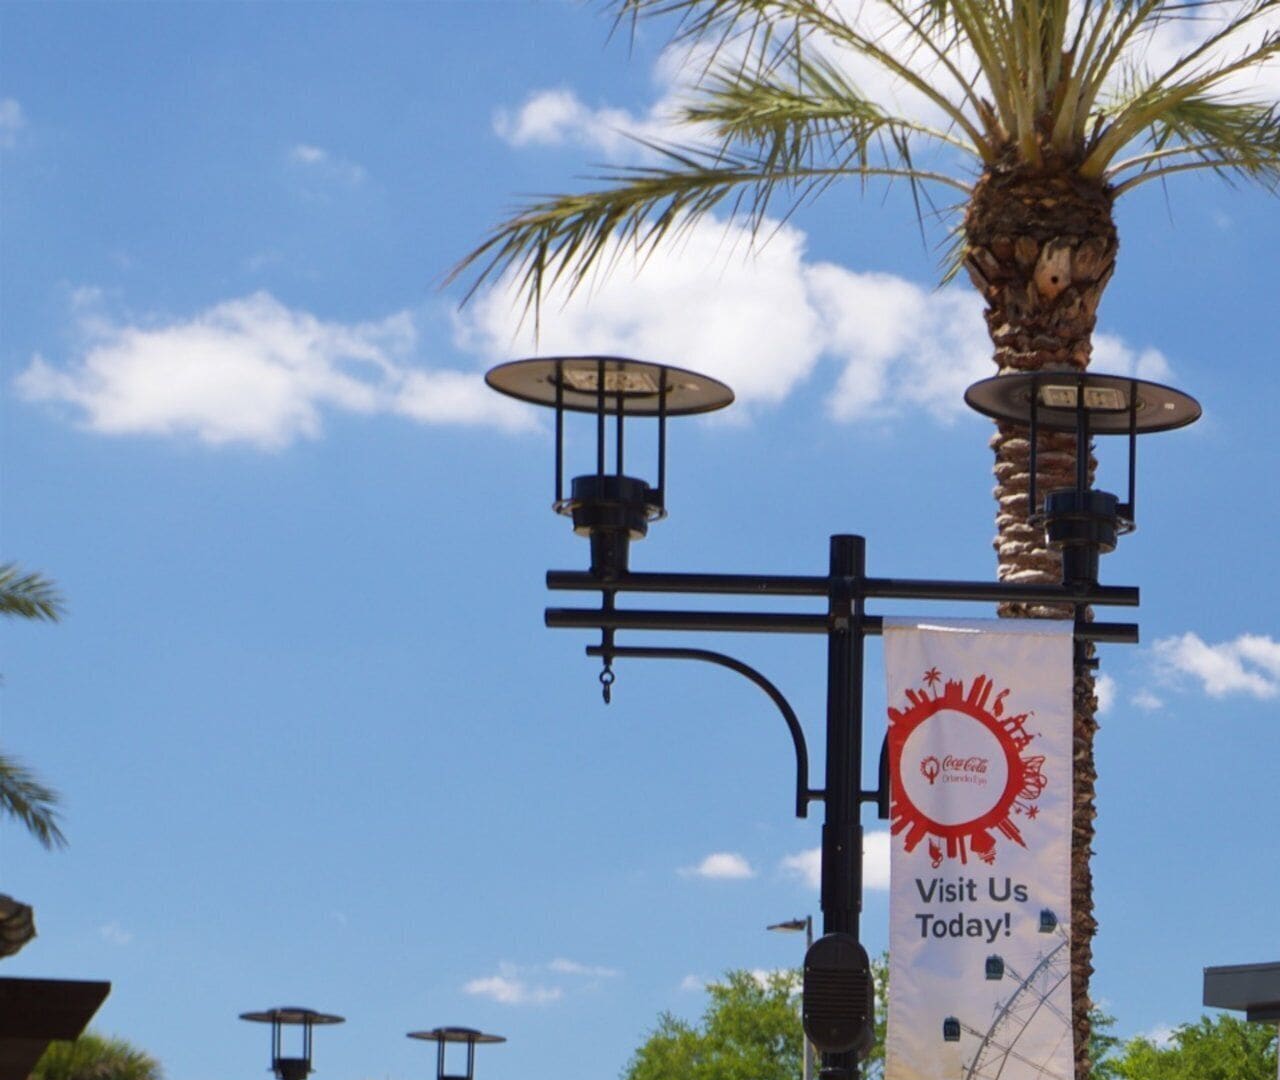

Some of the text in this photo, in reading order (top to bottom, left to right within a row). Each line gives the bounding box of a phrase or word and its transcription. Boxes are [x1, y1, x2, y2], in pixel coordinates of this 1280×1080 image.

[915, 877, 1028, 903] Visit Us
[915, 912, 1011, 943] Today!
